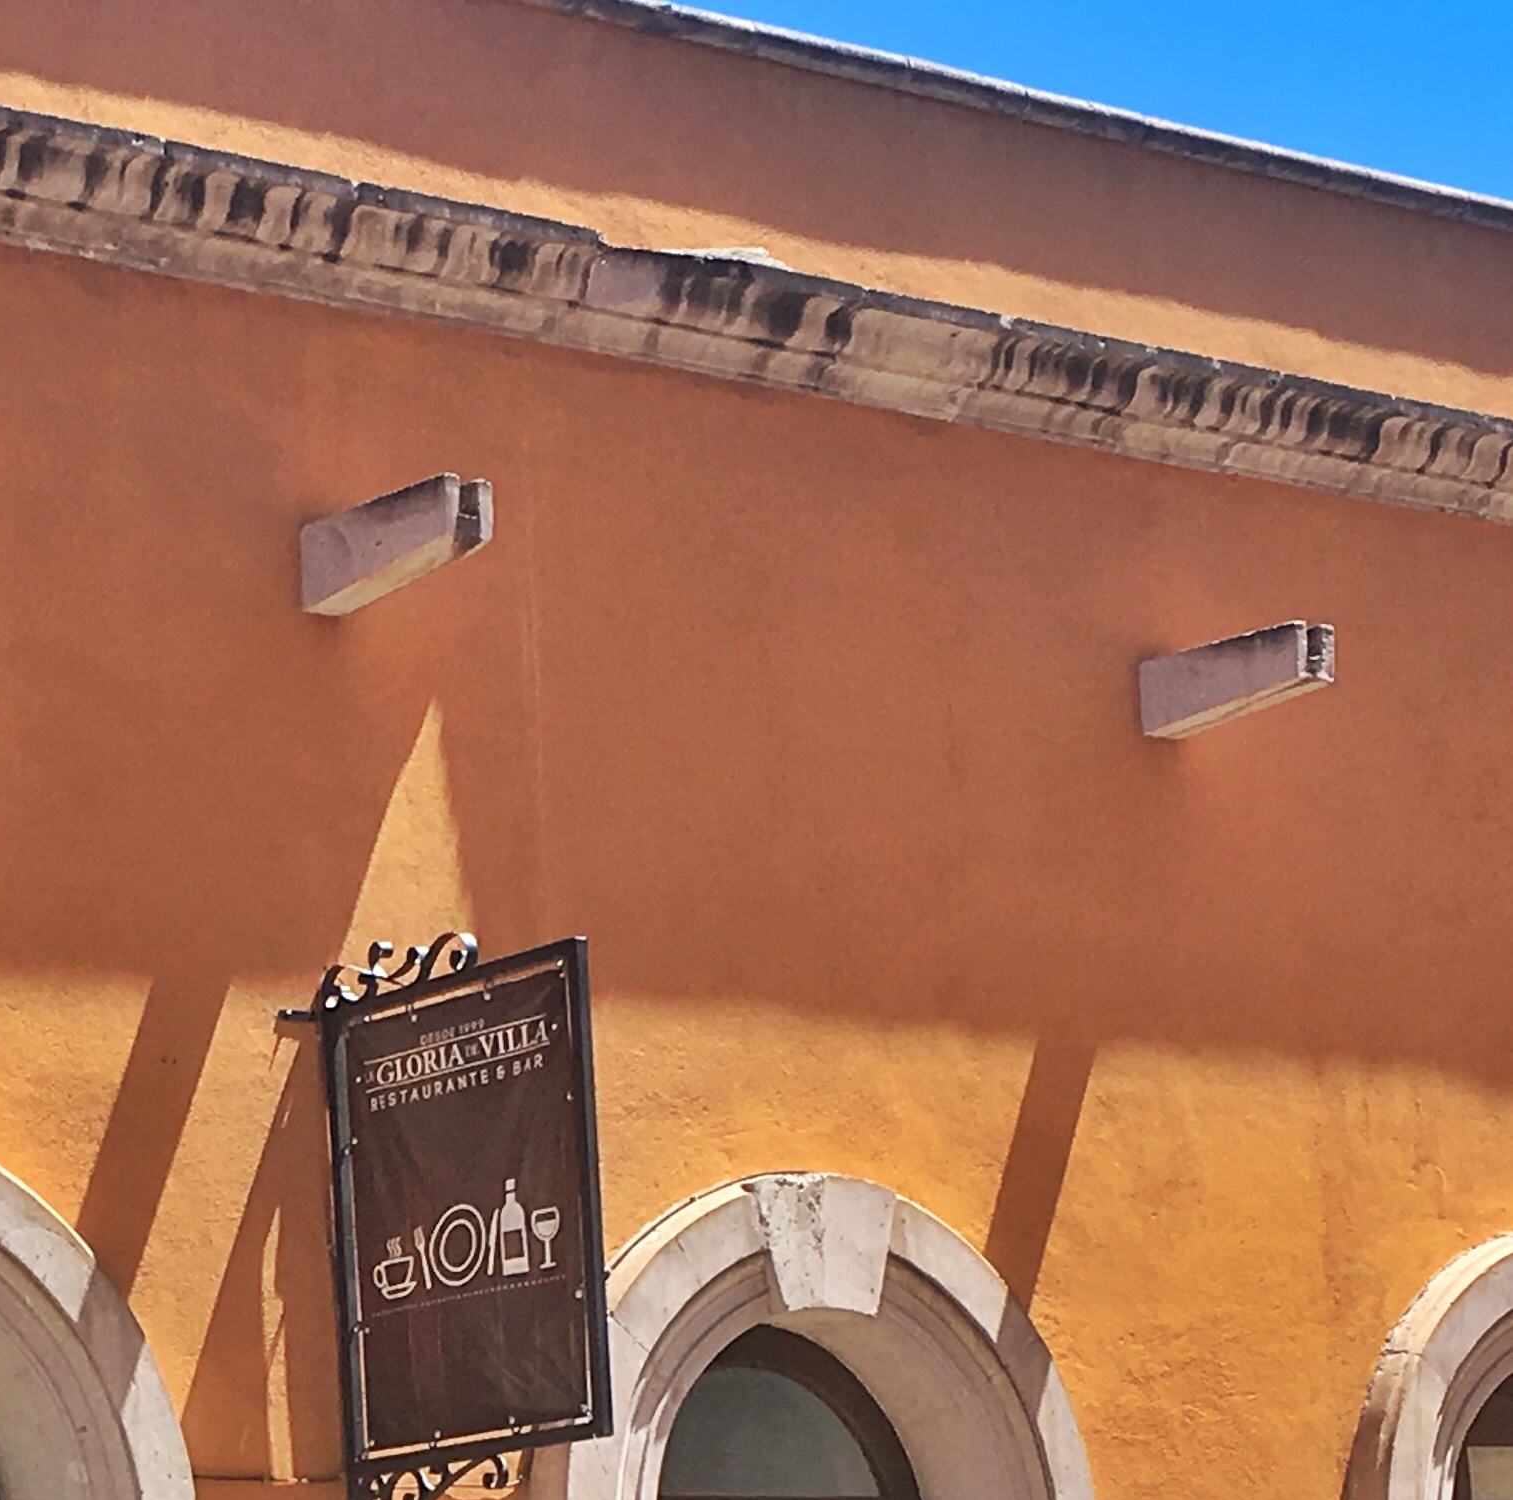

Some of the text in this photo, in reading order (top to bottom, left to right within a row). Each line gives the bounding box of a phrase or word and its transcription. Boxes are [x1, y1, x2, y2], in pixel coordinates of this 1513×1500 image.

[370, 1054, 544, 1112] RESTAURANTE & BAR
[376, 1043, 464, 1085] GLORIA
[478, 1020, 550, 1058] VILLA
